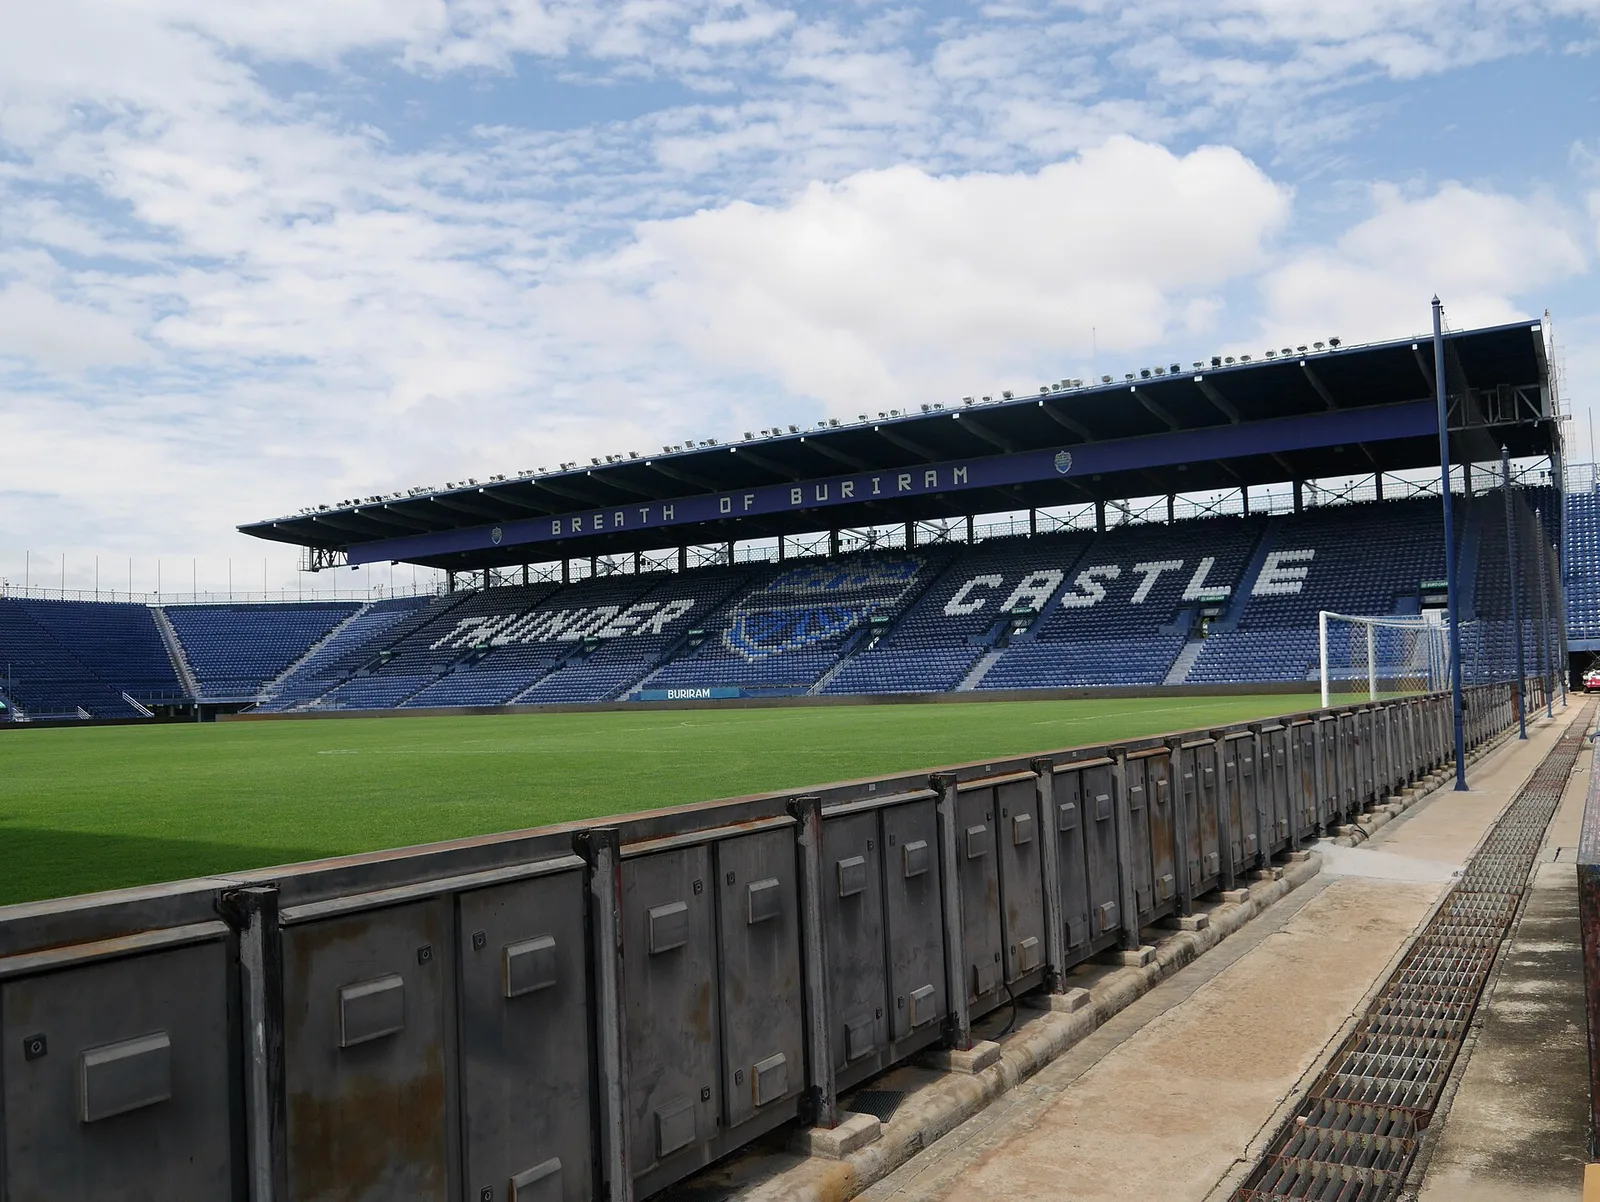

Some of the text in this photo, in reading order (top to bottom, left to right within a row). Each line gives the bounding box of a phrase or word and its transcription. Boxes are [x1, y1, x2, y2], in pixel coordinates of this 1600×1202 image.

[551, 466, 968, 535] BREATH OF BURIRAM
[429, 549, 1315, 651] THUNDER CASTLE
[667, 688, 711, 699] BURIRAM
